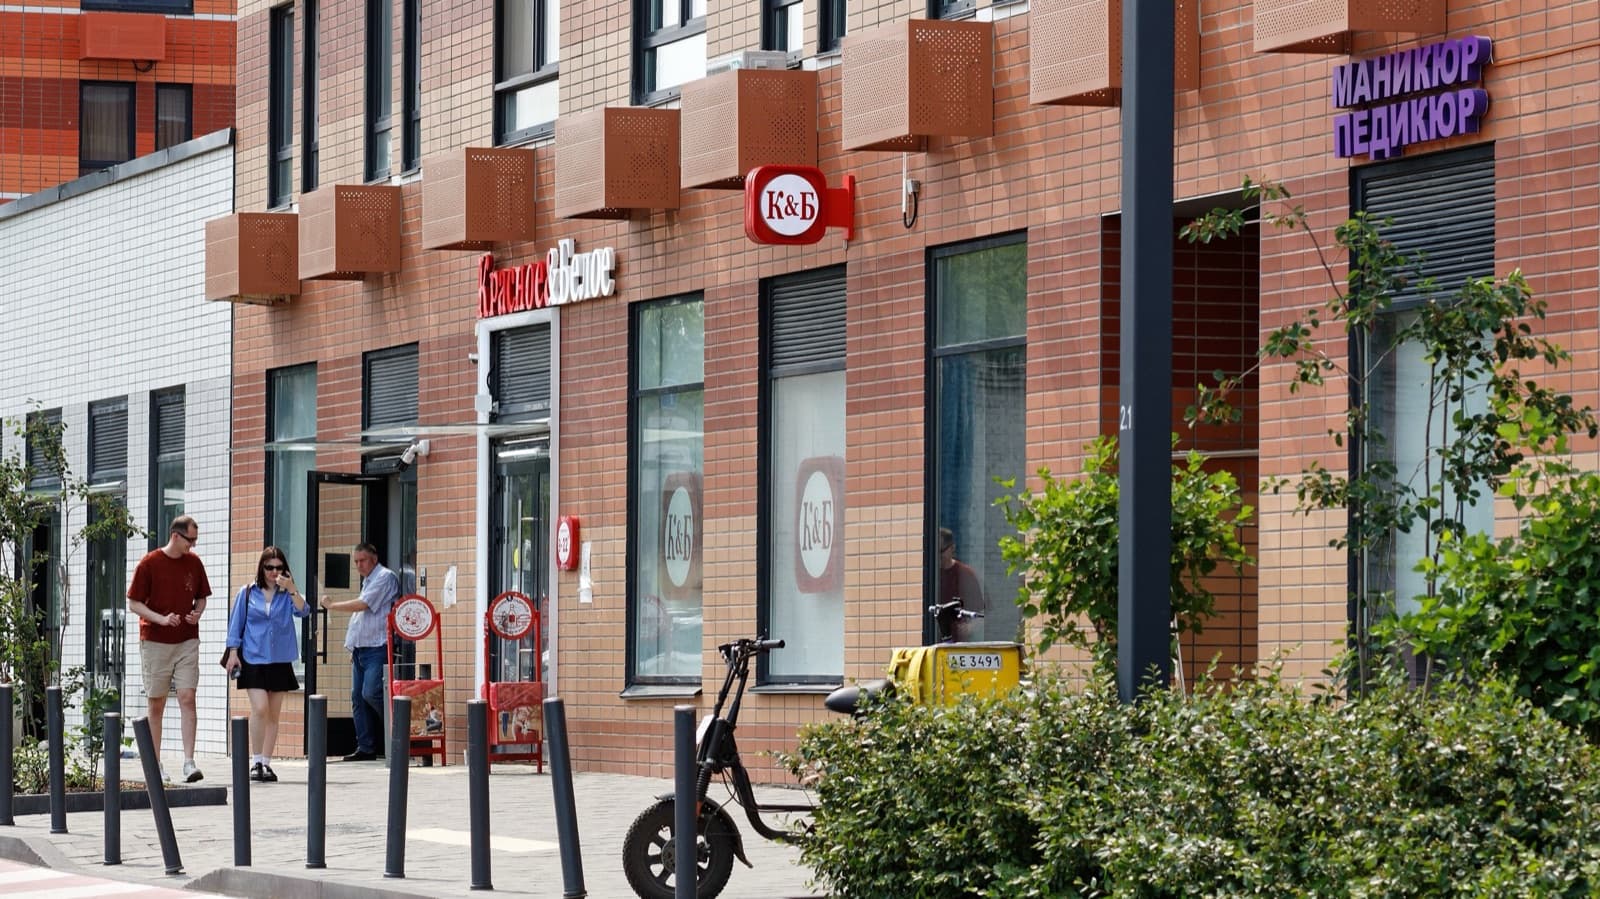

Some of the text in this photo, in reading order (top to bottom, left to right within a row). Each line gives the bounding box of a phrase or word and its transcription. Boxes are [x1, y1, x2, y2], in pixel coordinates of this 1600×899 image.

[1333, 35, 1484, 108] МАНИКЮР
[1334, 88, 1482, 160] ПЕДИКЮР
[766, 190, 816, 221] К&Б
[666, 513, 692, 561] К&Б
[801, 500, 832, 551] К&Б
[969, 655, 1000, 668] 3491
